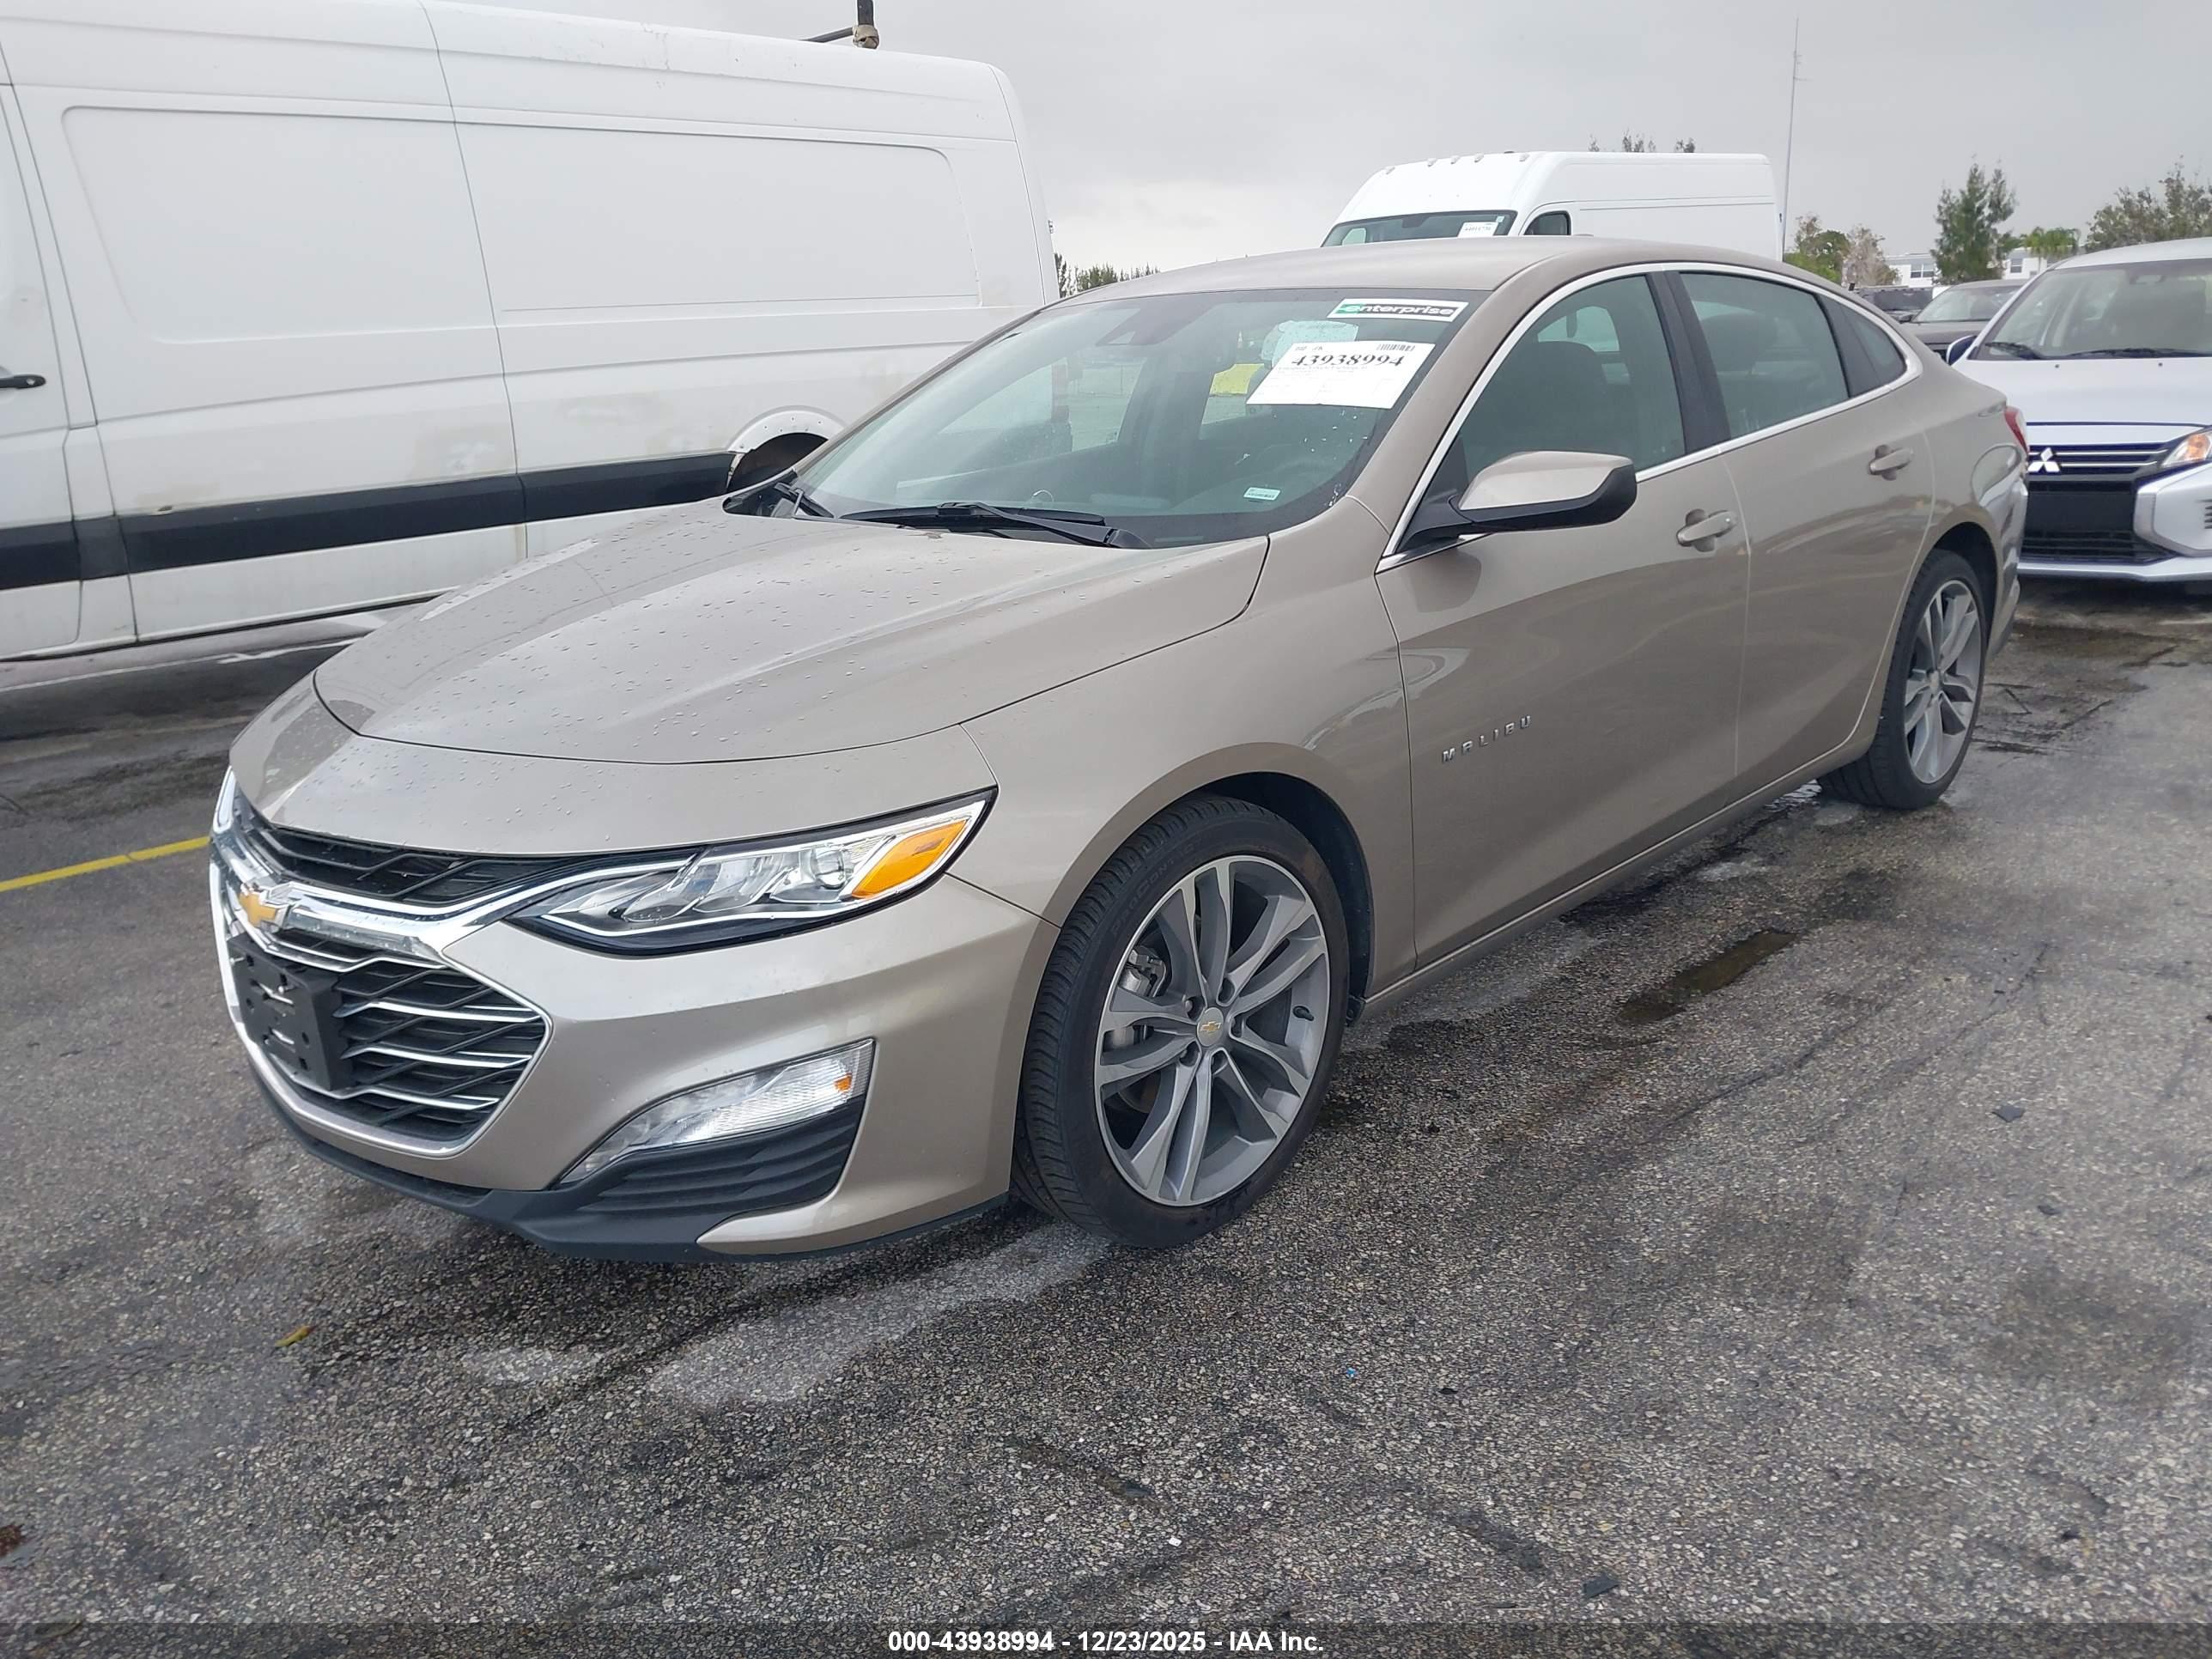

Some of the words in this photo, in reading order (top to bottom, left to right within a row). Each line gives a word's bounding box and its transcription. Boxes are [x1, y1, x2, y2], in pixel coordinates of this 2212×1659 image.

[1346, 303, 1454, 315] enterprise
[1291, 354, 1405, 367] 43938994
[1442, 715, 1531, 763] MALIBU
